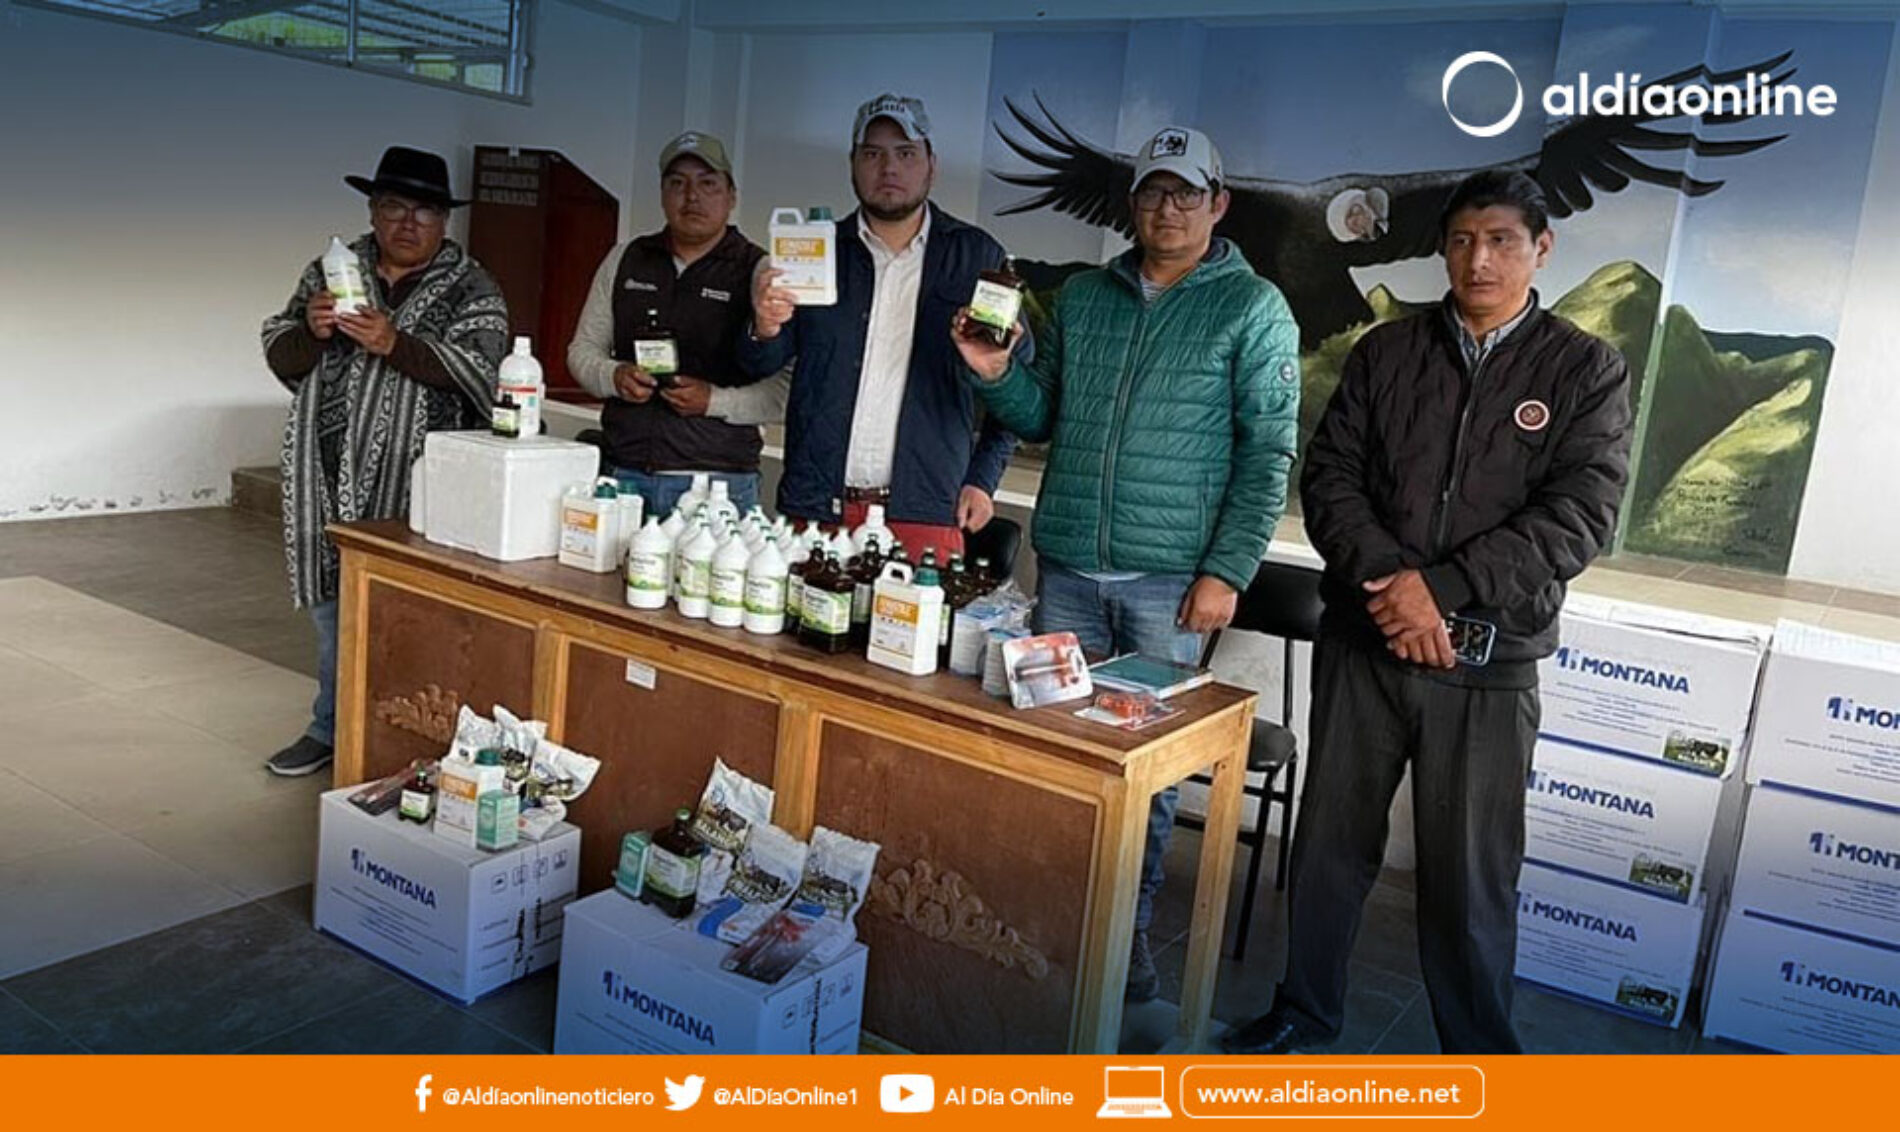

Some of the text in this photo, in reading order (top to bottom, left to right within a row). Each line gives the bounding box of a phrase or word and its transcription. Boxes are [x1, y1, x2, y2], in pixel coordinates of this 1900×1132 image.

[1580, 656, 1689, 694] MONTANA
[1549, 780, 1655, 819] MONTANA
[365, 860, 436, 910] MONTANA
[1533, 900, 1637, 943] MONTANA
[622, 986, 715, 1047] MONTANA
